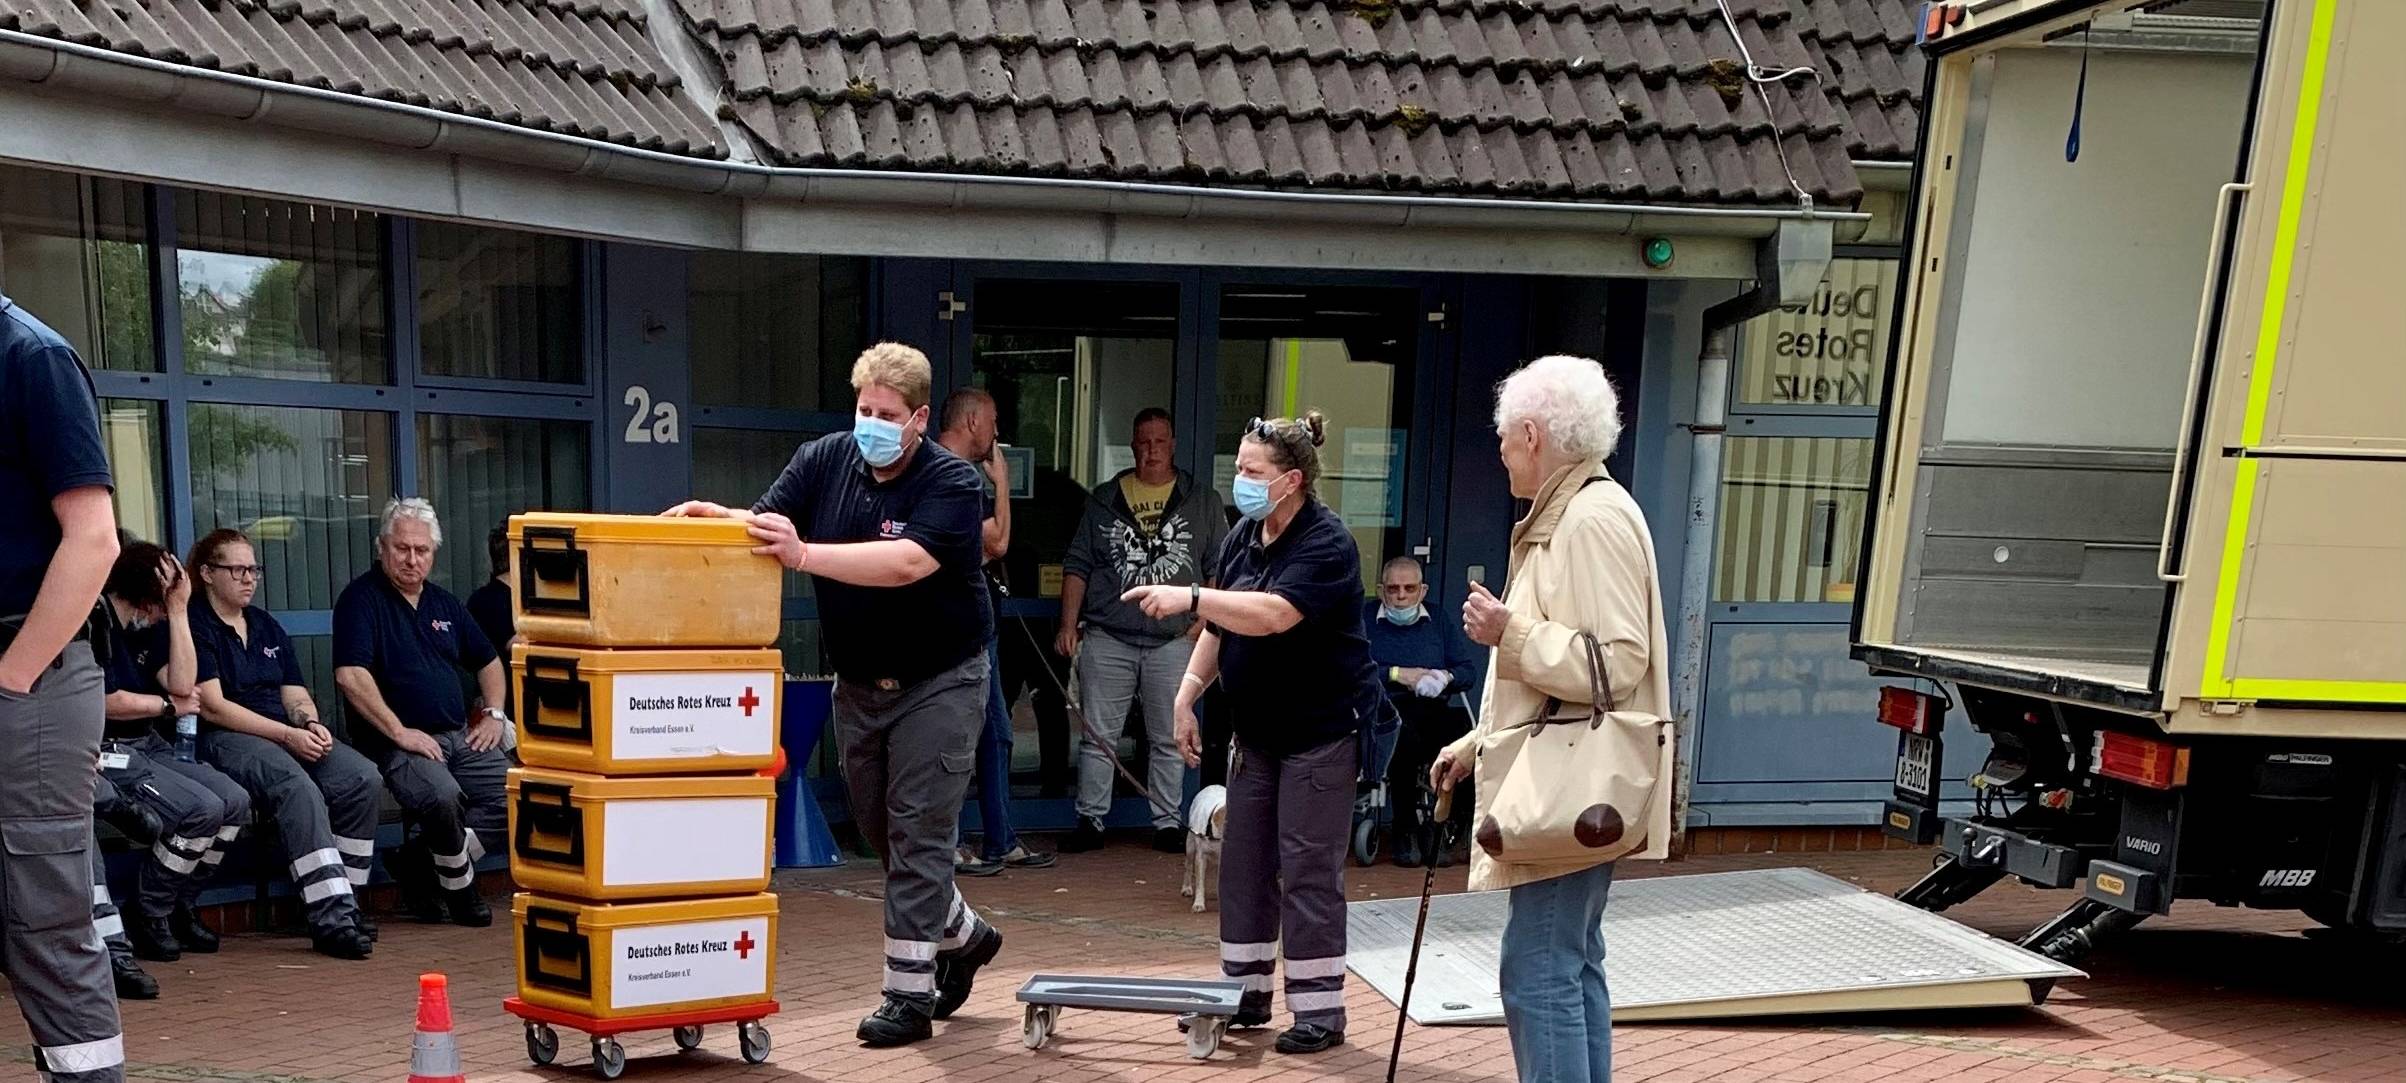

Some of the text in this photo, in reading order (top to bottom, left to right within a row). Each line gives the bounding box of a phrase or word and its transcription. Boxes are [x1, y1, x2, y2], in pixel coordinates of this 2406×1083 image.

[624, 386, 679, 443] 2a
[629, 695, 731, 710] Deutsches Rotes Kreuz
[629, 725, 666, 735] Kreisverband
[667, 724, 685, 734] Essen
[2126, 835, 2161, 855] VARIO
[2259, 869, 2317, 887] MBB
[628, 940, 728, 959] Deutsches Rotes Kreuz
[628, 970, 664, 982] Kreisverband
[664, 969, 681, 979] Essen
